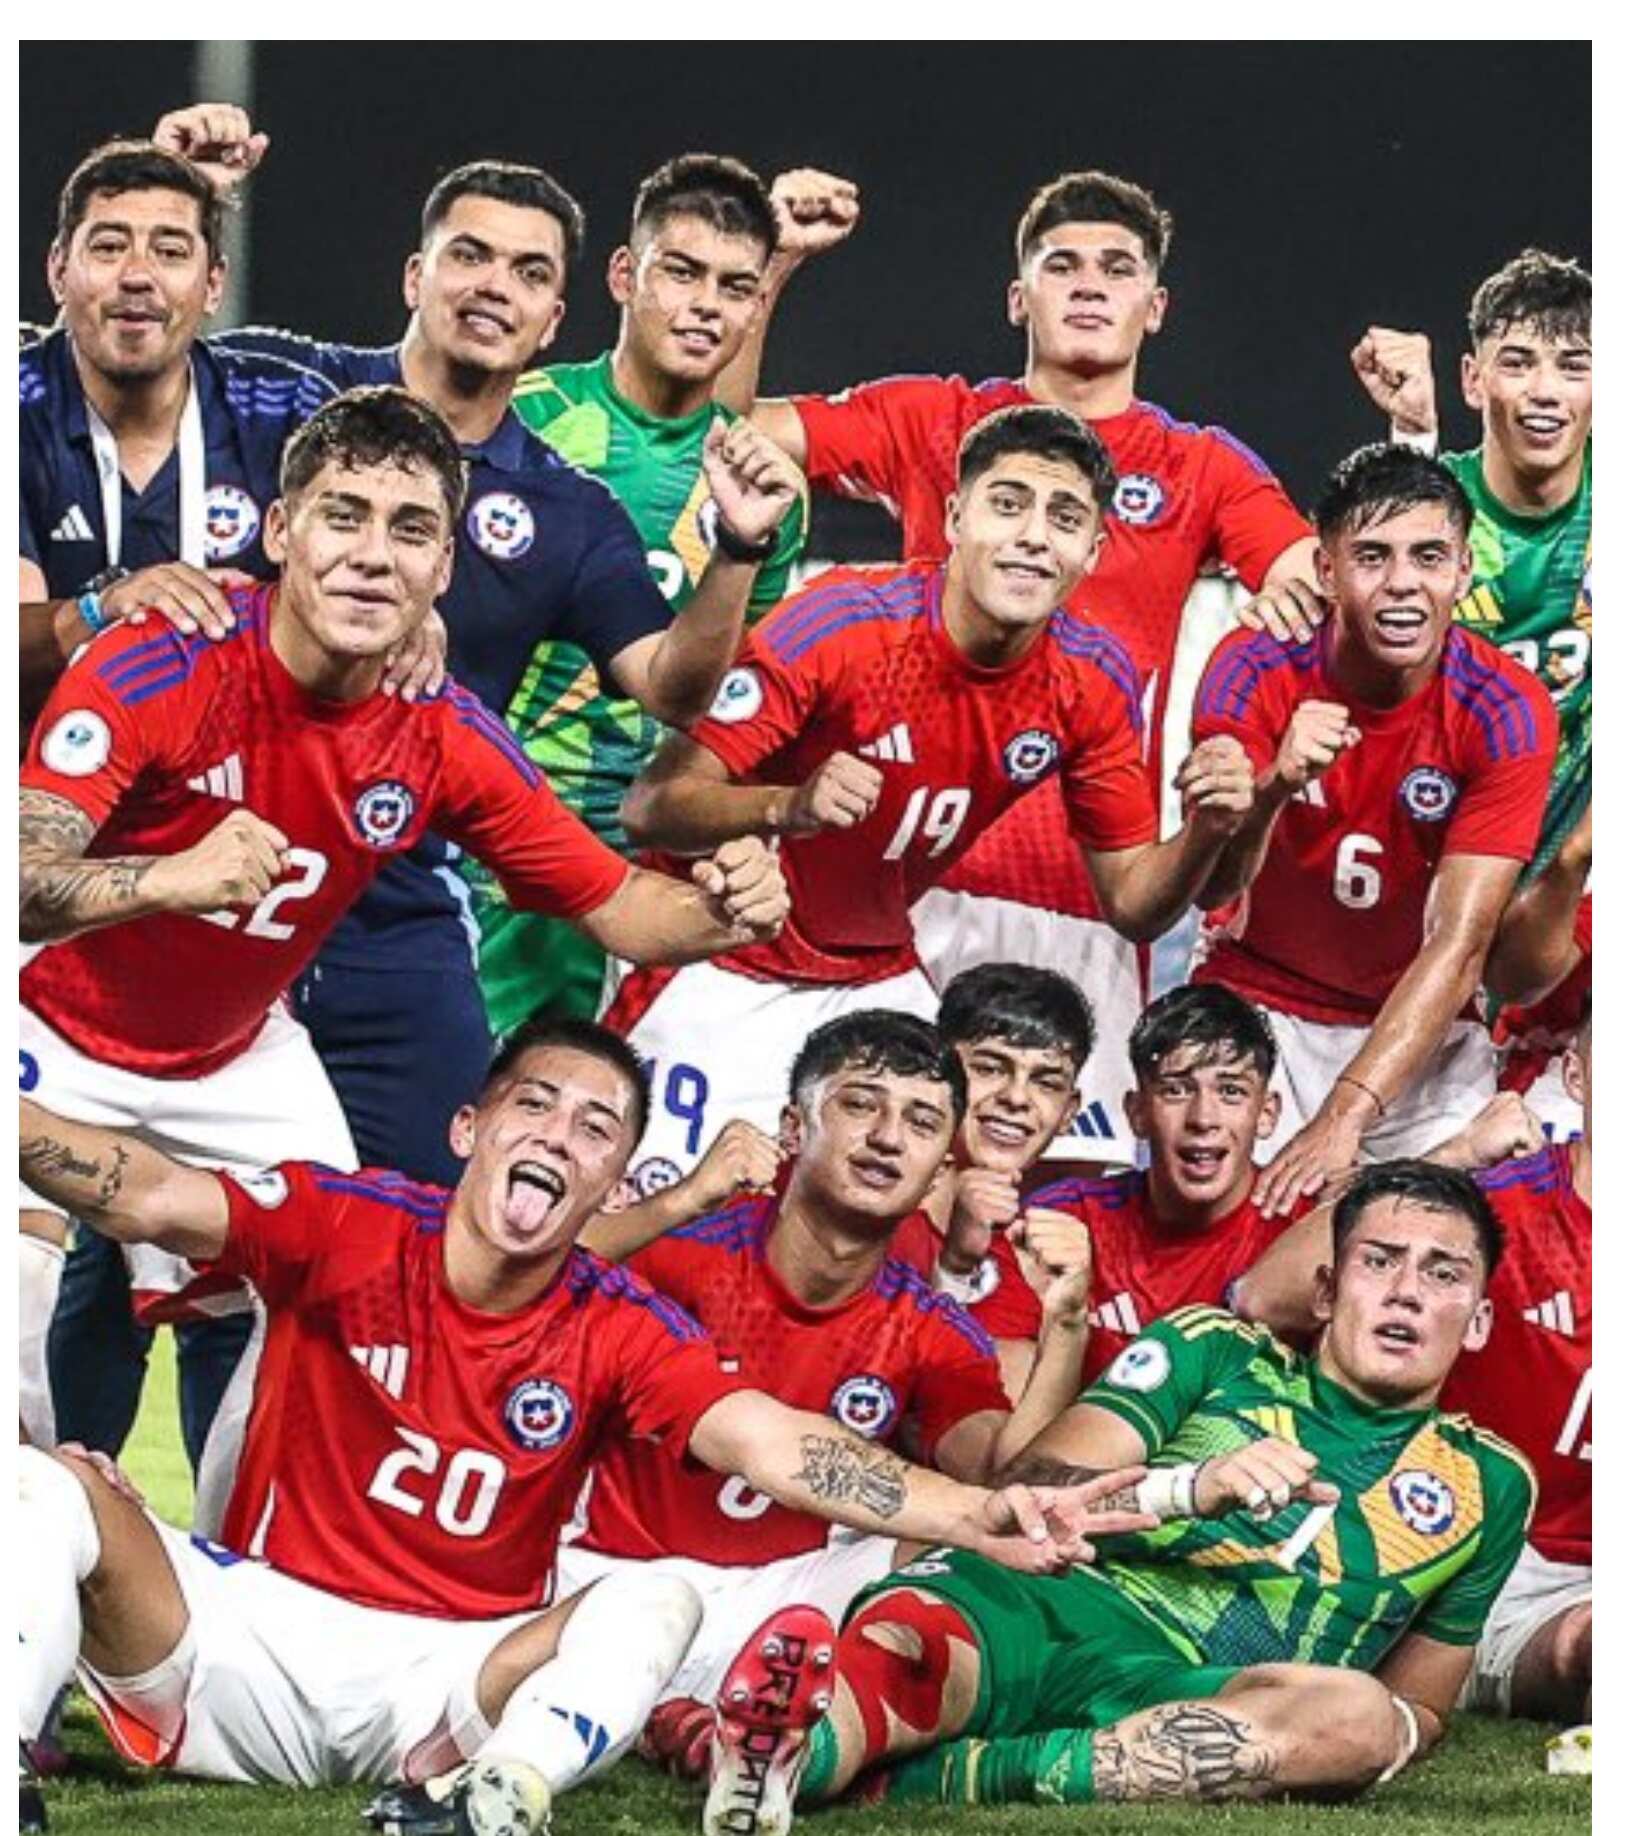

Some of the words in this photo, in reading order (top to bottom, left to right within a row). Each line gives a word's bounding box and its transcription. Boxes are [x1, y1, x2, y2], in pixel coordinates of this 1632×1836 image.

[882, 786, 971, 859] 19
[198, 848, 328, 940] 2
[1334, 833, 1384, 909] 6
[367, 1426, 507, 1536] 20
